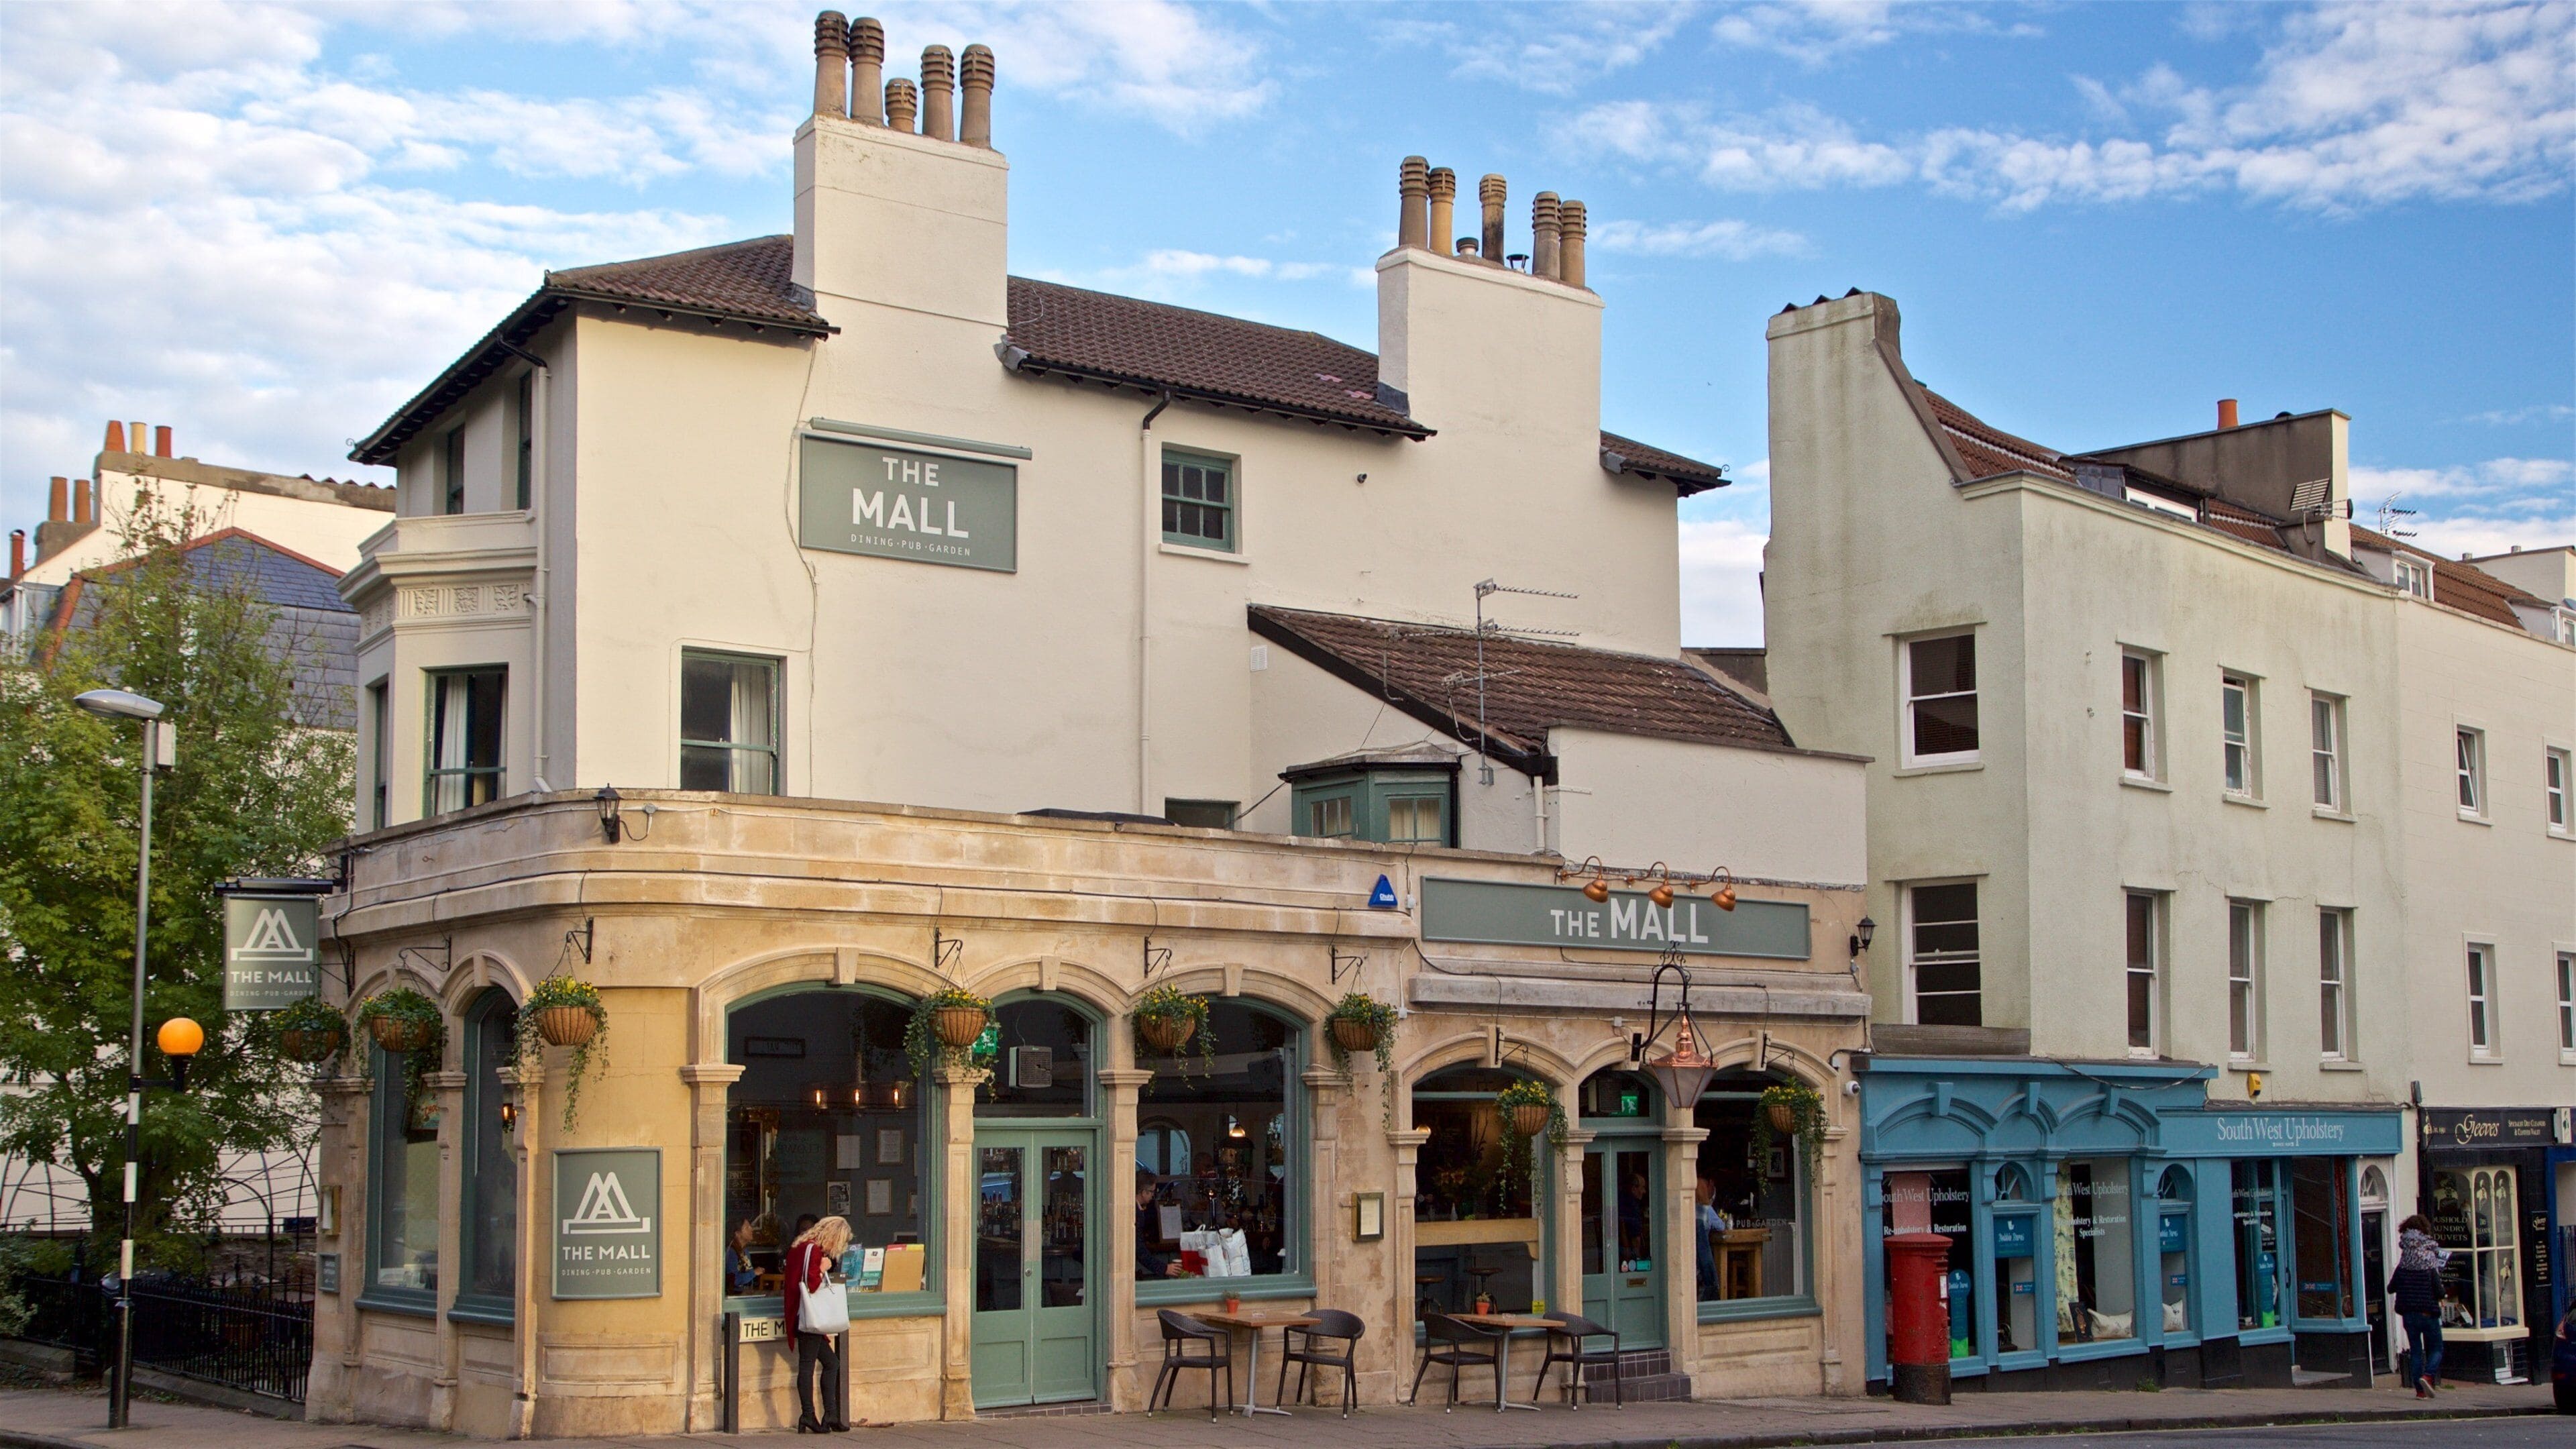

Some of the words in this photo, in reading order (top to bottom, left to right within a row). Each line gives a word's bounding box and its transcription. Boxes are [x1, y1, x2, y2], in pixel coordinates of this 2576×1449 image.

[882, 456, 939, 487] THE
[853, 487, 969, 539] MALL
[851, 533, 894, 547] DINING
[901, 539, 922, 551] PUB
[928, 543, 971, 557] GARDEN
[1550, 908, 1600, 938] THE
[1610, 897, 1709, 944] MALL
[231, 971, 263, 983] THE
[268, 971, 313, 983] MALL
[2217, 1117, 2253, 1140] South
[2252, 1117, 2283, 1140] West
[2284, 1117, 2344, 1146] Upholstery
[2455, 1114, 2500, 1144] Geeves
[1903, 1188, 1925, 1202] West
[1927, 1187, 1970, 1206] Upholstery
[2072, 1182, 2091, 1195] West
[2092, 1181, 2129, 1199] Upholstery
[1736, 1219, 1752, 1228] PUB
[1755, 1218, 1787, 1228] GARDEN
[2092, 1216, 2098, 1224] &
[2098, 1214, 2127, 1224] Restoration
[1926, 1224, 1932, 1234] &
[1934, 1222, 1967, 1233] Restoration
[2079, 1228, 2105, 1239] Specialists
[562, 1246, 593, 1260] THE
[599, 1244, 651, 1260] MALL
[595, 1268, 611, 1276] PUB
[616, 1267, 651, 1275] GARDEN
[744, 1321, 768, 1338] THE
